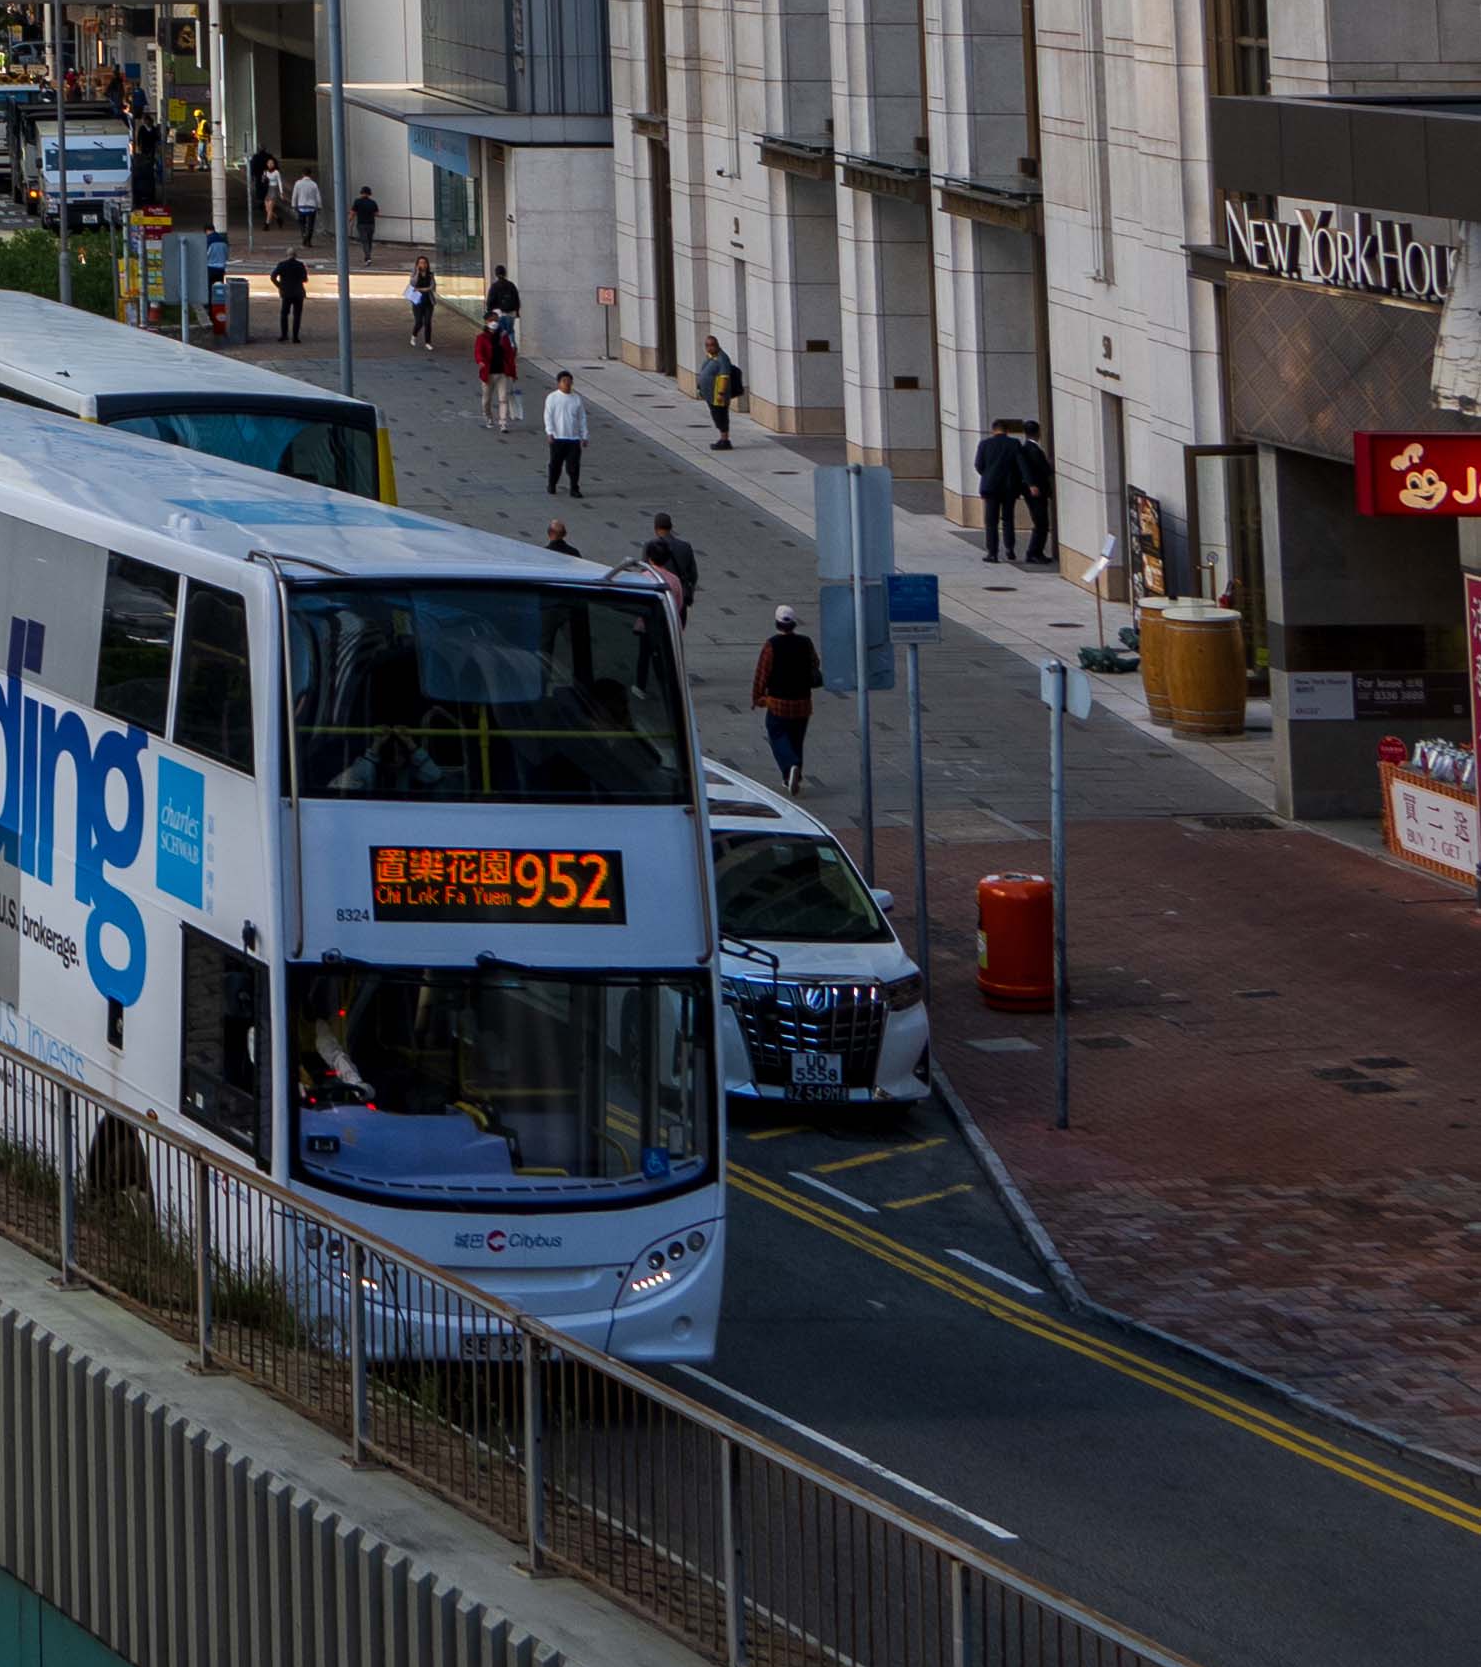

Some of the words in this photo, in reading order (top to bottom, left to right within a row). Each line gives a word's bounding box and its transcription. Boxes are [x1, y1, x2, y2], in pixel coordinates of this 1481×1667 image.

[1377, 678, 1402, 688] lease
[161, 797, 199, 840] charles
[160, 831, 199, 866] SCHWAB
[1430, 837, 1438, 853] 2
[1441, 841, 1461, 860] GET
[376, 849, 511, 884] 置樂花園
[515, 854, 611, 909] 952
[376, 886, 401, 905] Chi
[445, 886, 466, 905] Fa
[474, 886, 511, 906] Yuen
[336, 909, 369, 922] 8324
[22, 906, 80, 968] brokerage.
[27, 1014, 85, 1083] Invests
[795, 1069, 838, 1082] 5558
[454, 1232, 485, 1249] 城巴
[509, 1232, 563, 1249] Citybus
